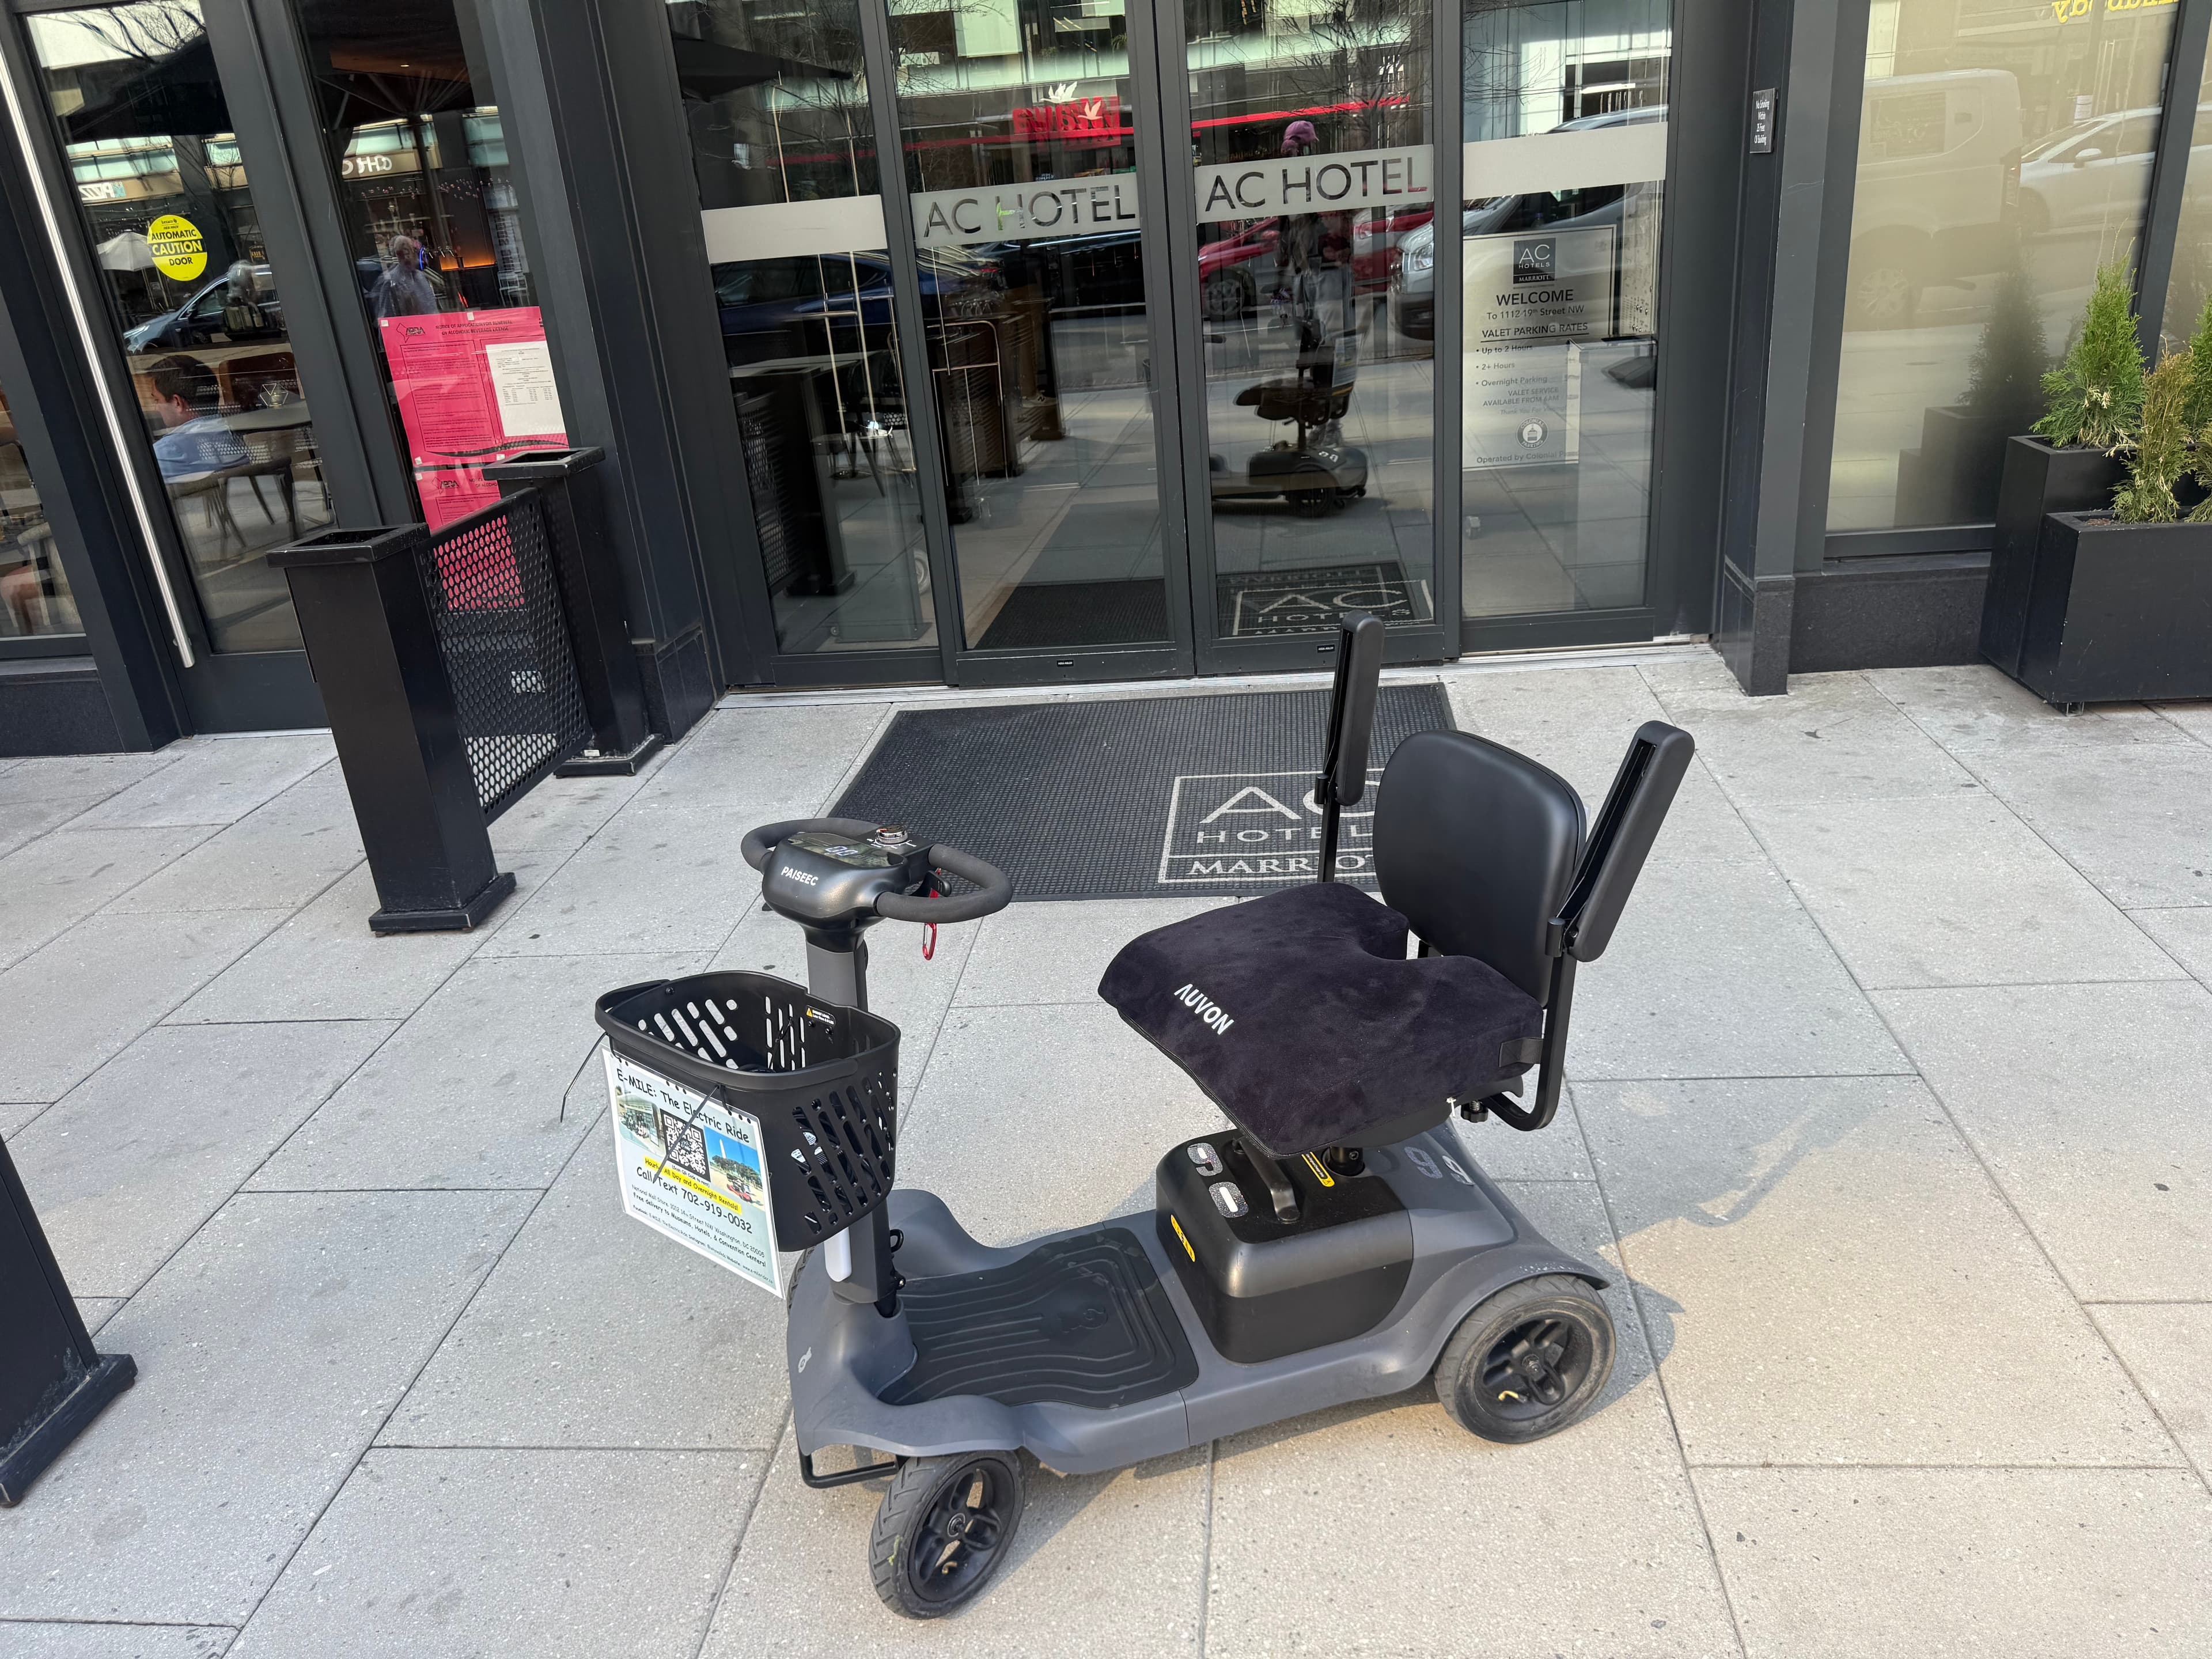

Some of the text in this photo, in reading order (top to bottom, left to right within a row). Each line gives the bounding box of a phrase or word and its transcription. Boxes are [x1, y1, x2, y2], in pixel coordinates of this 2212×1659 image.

[1205, 157, 1428, 212] AC HOTEL
[923, 185, 1136, 237] AC HOTEL
[151, 229, 196, 241] AUTOMATIC
[151, 240, 203, 256] CAUTION
[1519, 244, 1550, 264] AC
[169, 257, 193, 266] DOOR
[1497, 289, 1574, 306] WELCOME
[1501, 310, 1520, 319] 1112
[1540, 307, 1565, 316] Street
[1568, 305, 1585, 313] NW
[1482, 323, 1588, 338] VALET PARKING RATES
[1481, 376, 1548, 387] Overnight Parking
[1483, 397, 1520, 406] AVAILABLE
[1522, 396, 1543, 404] FROM
[1476, 454, 1512, 464] Operated
[1526, 452, 1557, 460] Colonial
[1259, 590, 1408, 613] AC
[781, 866, 819, 886] PAISEEC
[1173, 983, 1235, 1036] AUVON
[616, 1068, 657, 1097] E-MILE:
[660, 1090, 680, 1109] The
[725, 1123, 749, 1143] Ride
[672, 1171, 681, 1183] Day
[683, 1179, 692, 1187] and
[694, 1183, 717, 1200] Overnight
[719, 1196, 738, 1211] Rentals!
[681, 1188, 752, 1234] 702-919-0032
[633, 1192, 645, 1202] Free
[645, 1198, 663, 1213] delivery
[718, 1238, 745, 1256] Convention
[689, 1214, 704, 1225] Street
[743, 1241, 749, 1249] DC
